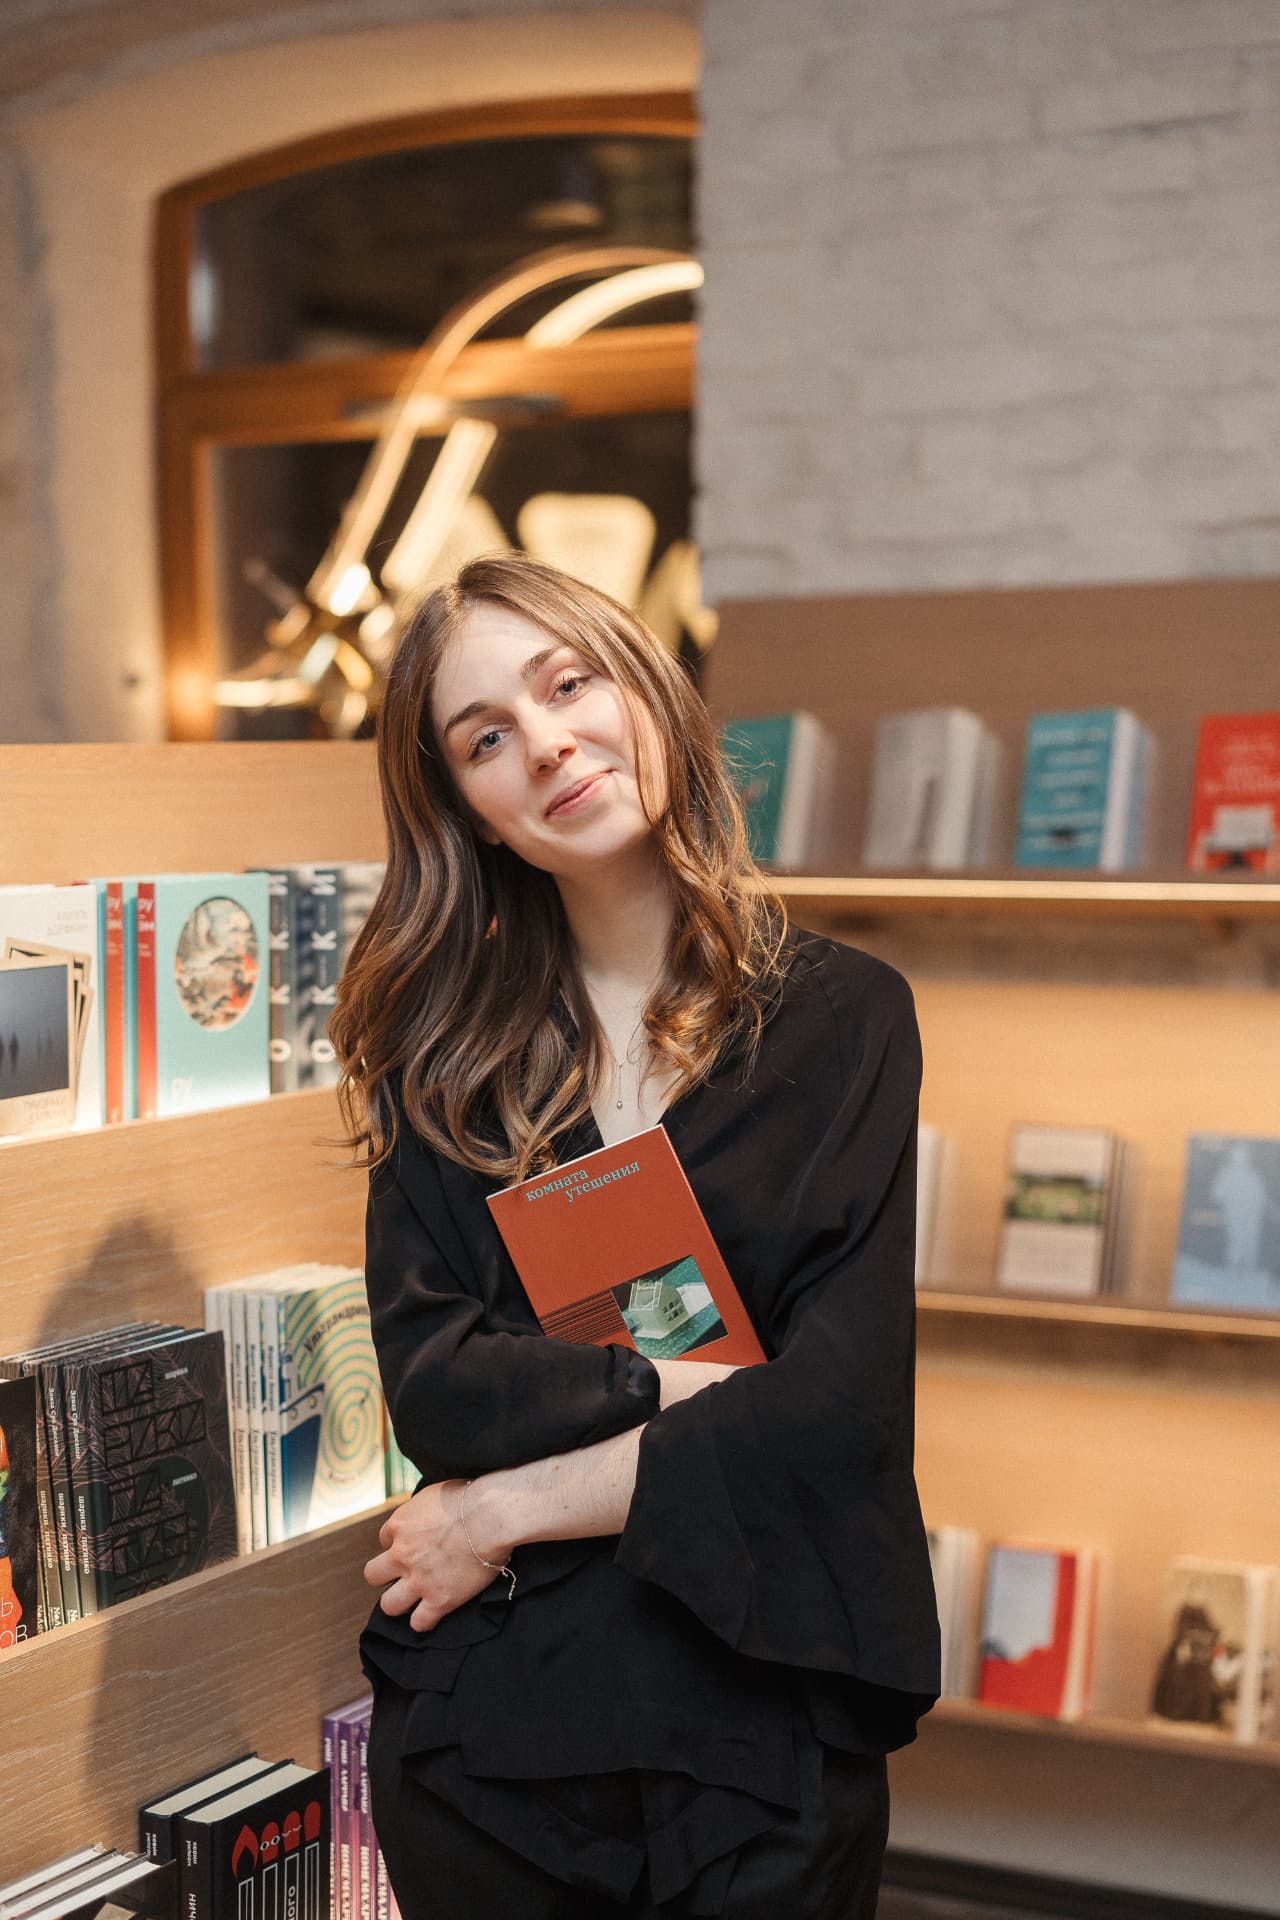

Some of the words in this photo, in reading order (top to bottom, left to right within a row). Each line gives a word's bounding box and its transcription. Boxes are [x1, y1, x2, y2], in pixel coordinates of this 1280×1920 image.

[526, 1169, 588, 1202] комната
[564, 1161, 641, 1203] утешения
[58, 1492, 67, 1528] шарики
[78, 1495, 87, 1531] шарики
[62, 1533, 71, 1572] патинко
[81, 1536, 90, 1575] патинко
